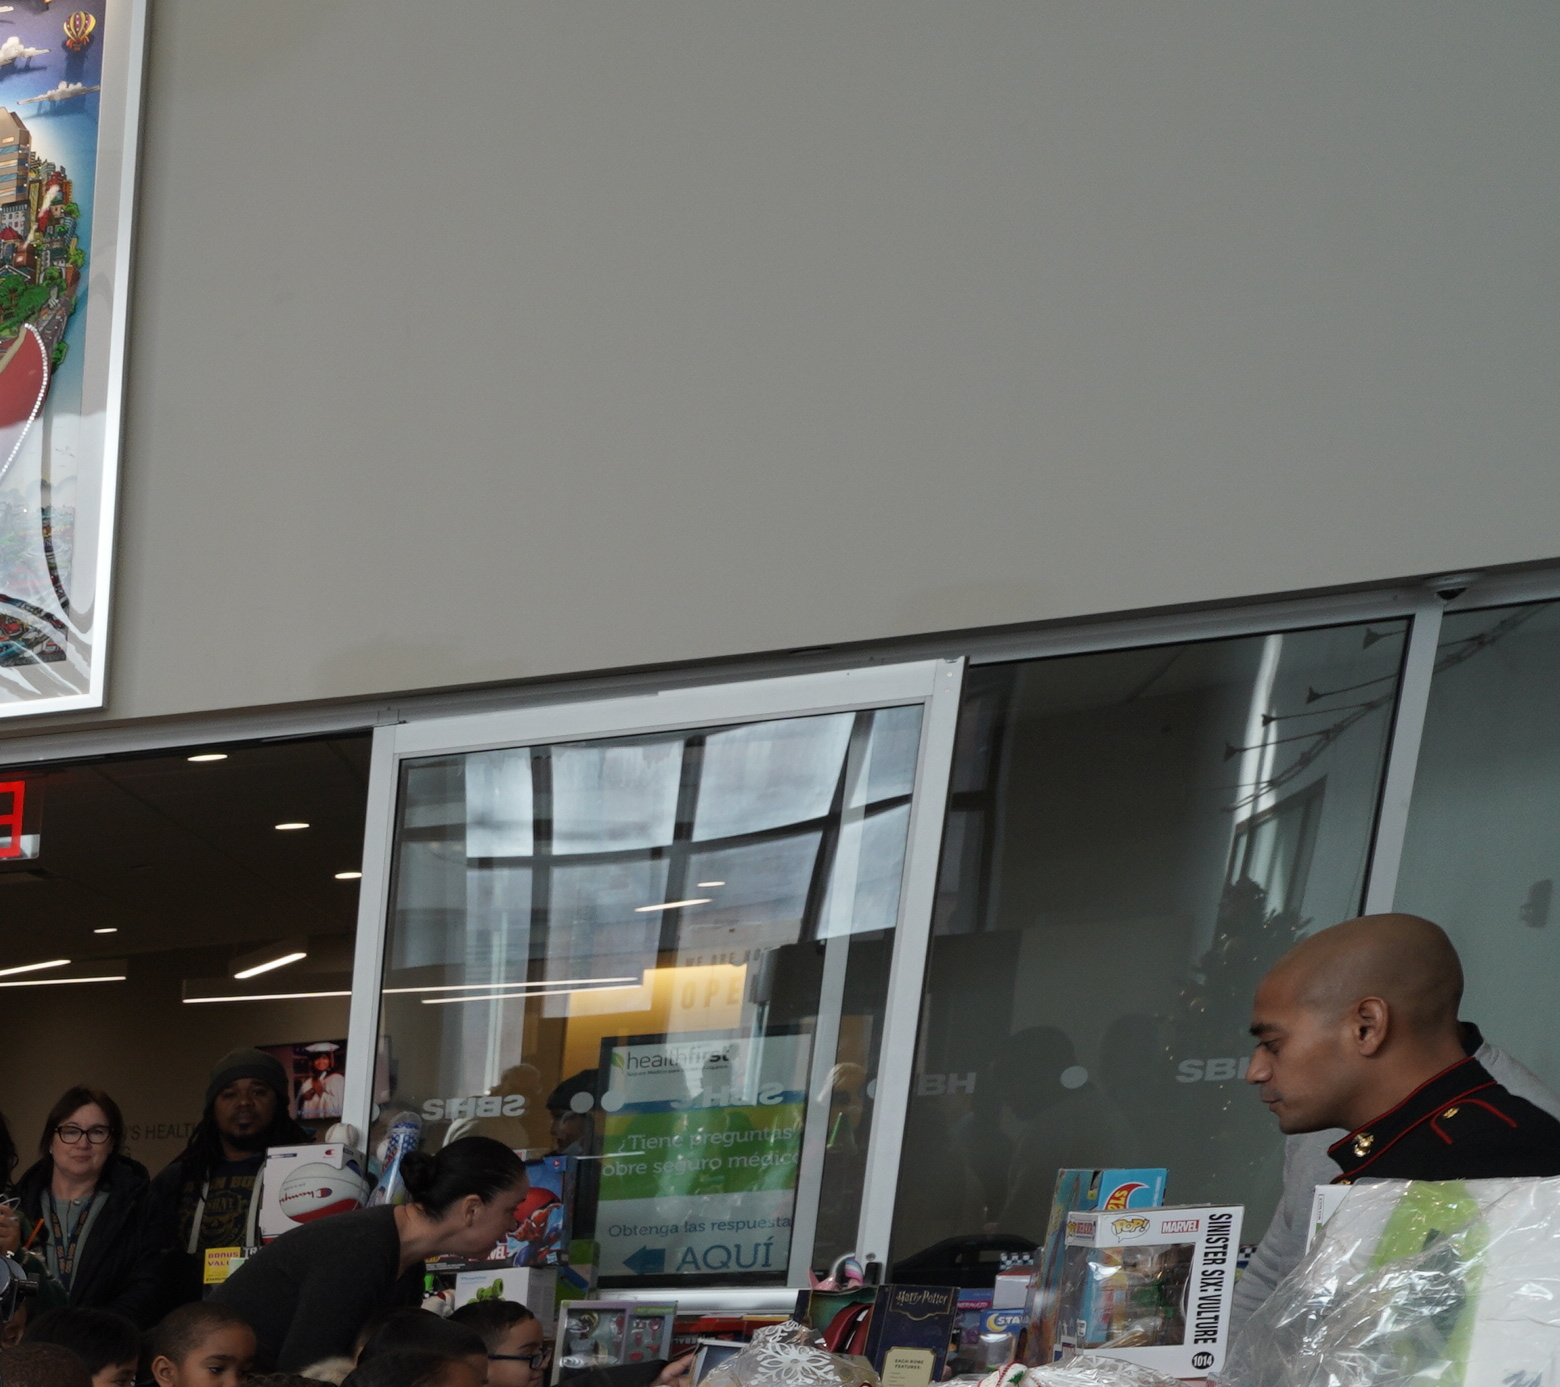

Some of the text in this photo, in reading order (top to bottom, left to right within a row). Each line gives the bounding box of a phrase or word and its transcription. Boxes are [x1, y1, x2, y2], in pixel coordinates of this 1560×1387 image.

[917, 1072, 977, 1097] BH
[145, 1122, 196, 1140] HEALT
[690, 1127, 793, 1148] preguntas
[653, 1157, 722, 1177] seguro
[608, 1222, 679, 1237] Obtenga
[684, 1219, 706, 1233] las
[1113, 1218, 1150, 1235] POP!
[1162, 1219, 1200, 1234] MARVEL
[487, 1245, 507, 1260] VEL
[676, 1236, 774, 1272] AQUÍ
[1193, 1213, 1233, 1345] SINISTER SIX: VULTURE
[896, 1290, 948, 1307] Harry Potter
[1193, 1355, 1213, 1367] 1014
